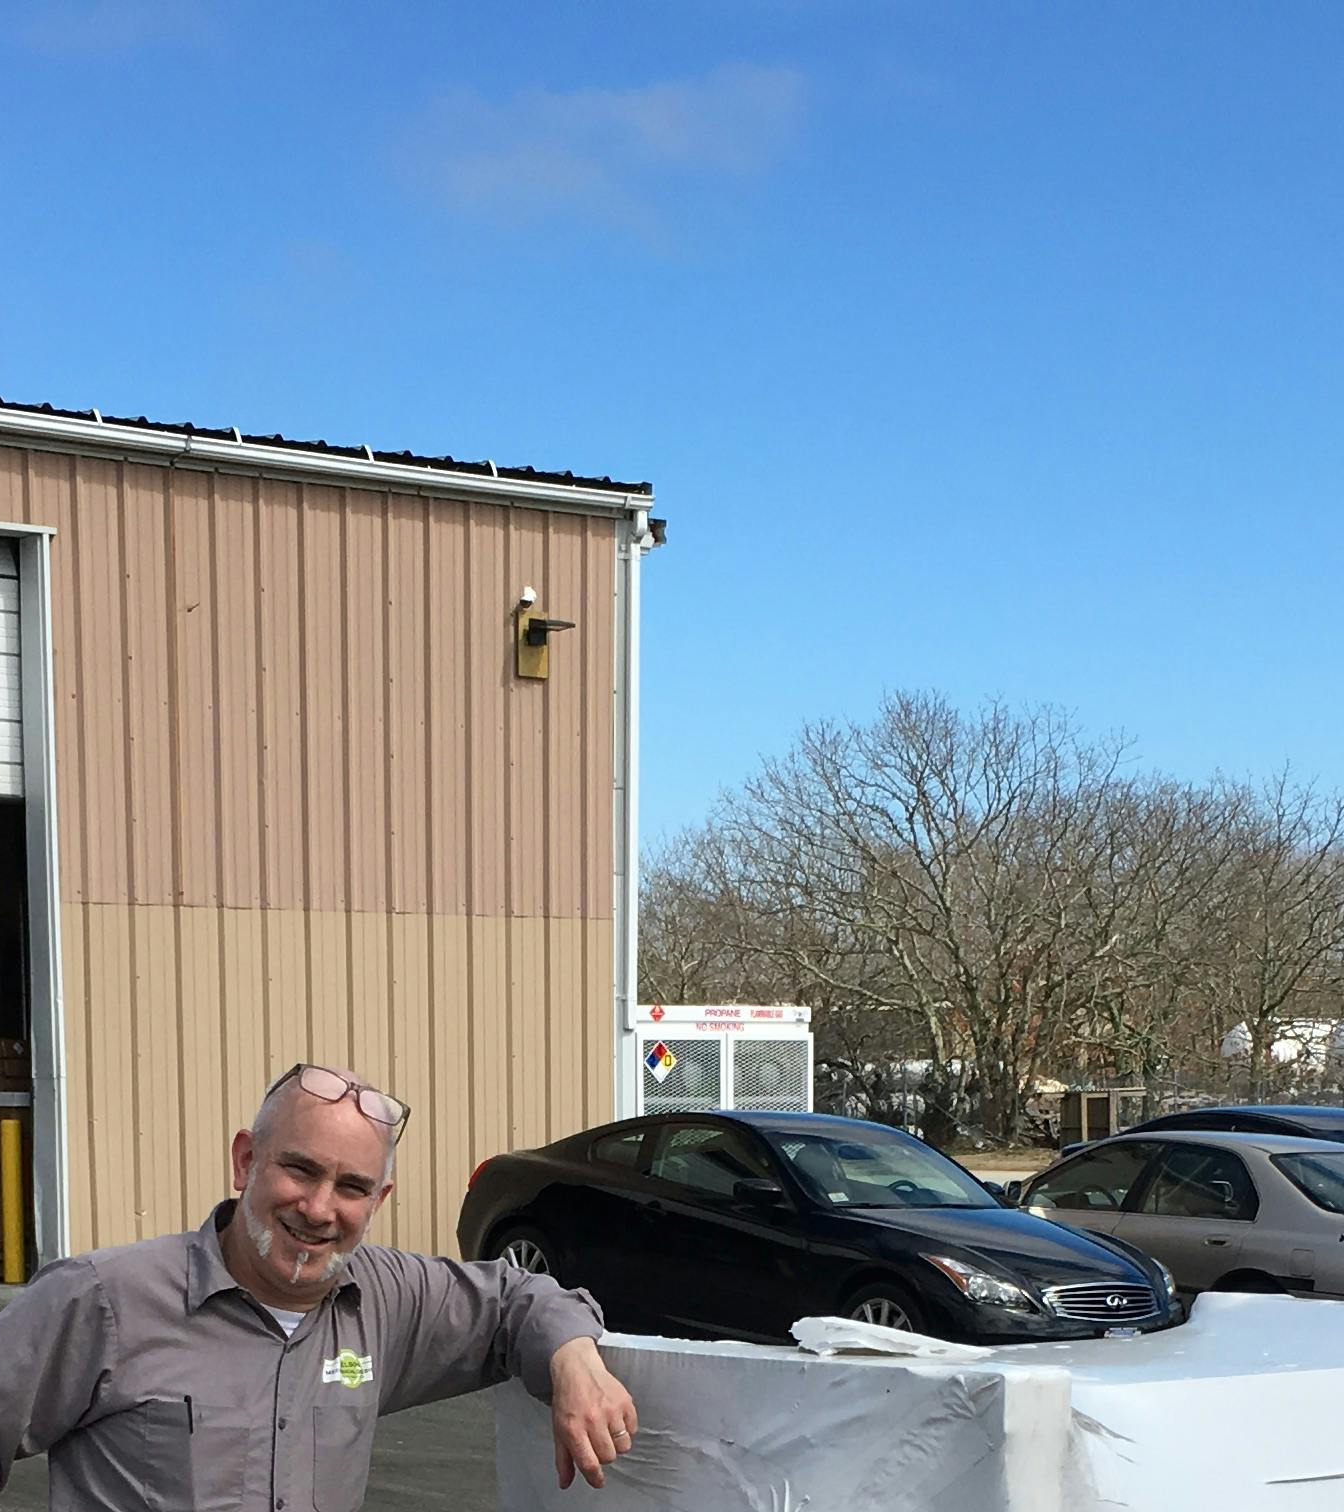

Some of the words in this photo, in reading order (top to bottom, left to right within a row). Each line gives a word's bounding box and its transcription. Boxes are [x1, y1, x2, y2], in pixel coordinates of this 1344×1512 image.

[705, 1009, 741, 1017] PROPANE
[696, 1022, 707, 1031] NO
[709, 1022, 744, 1032] SMOKING
